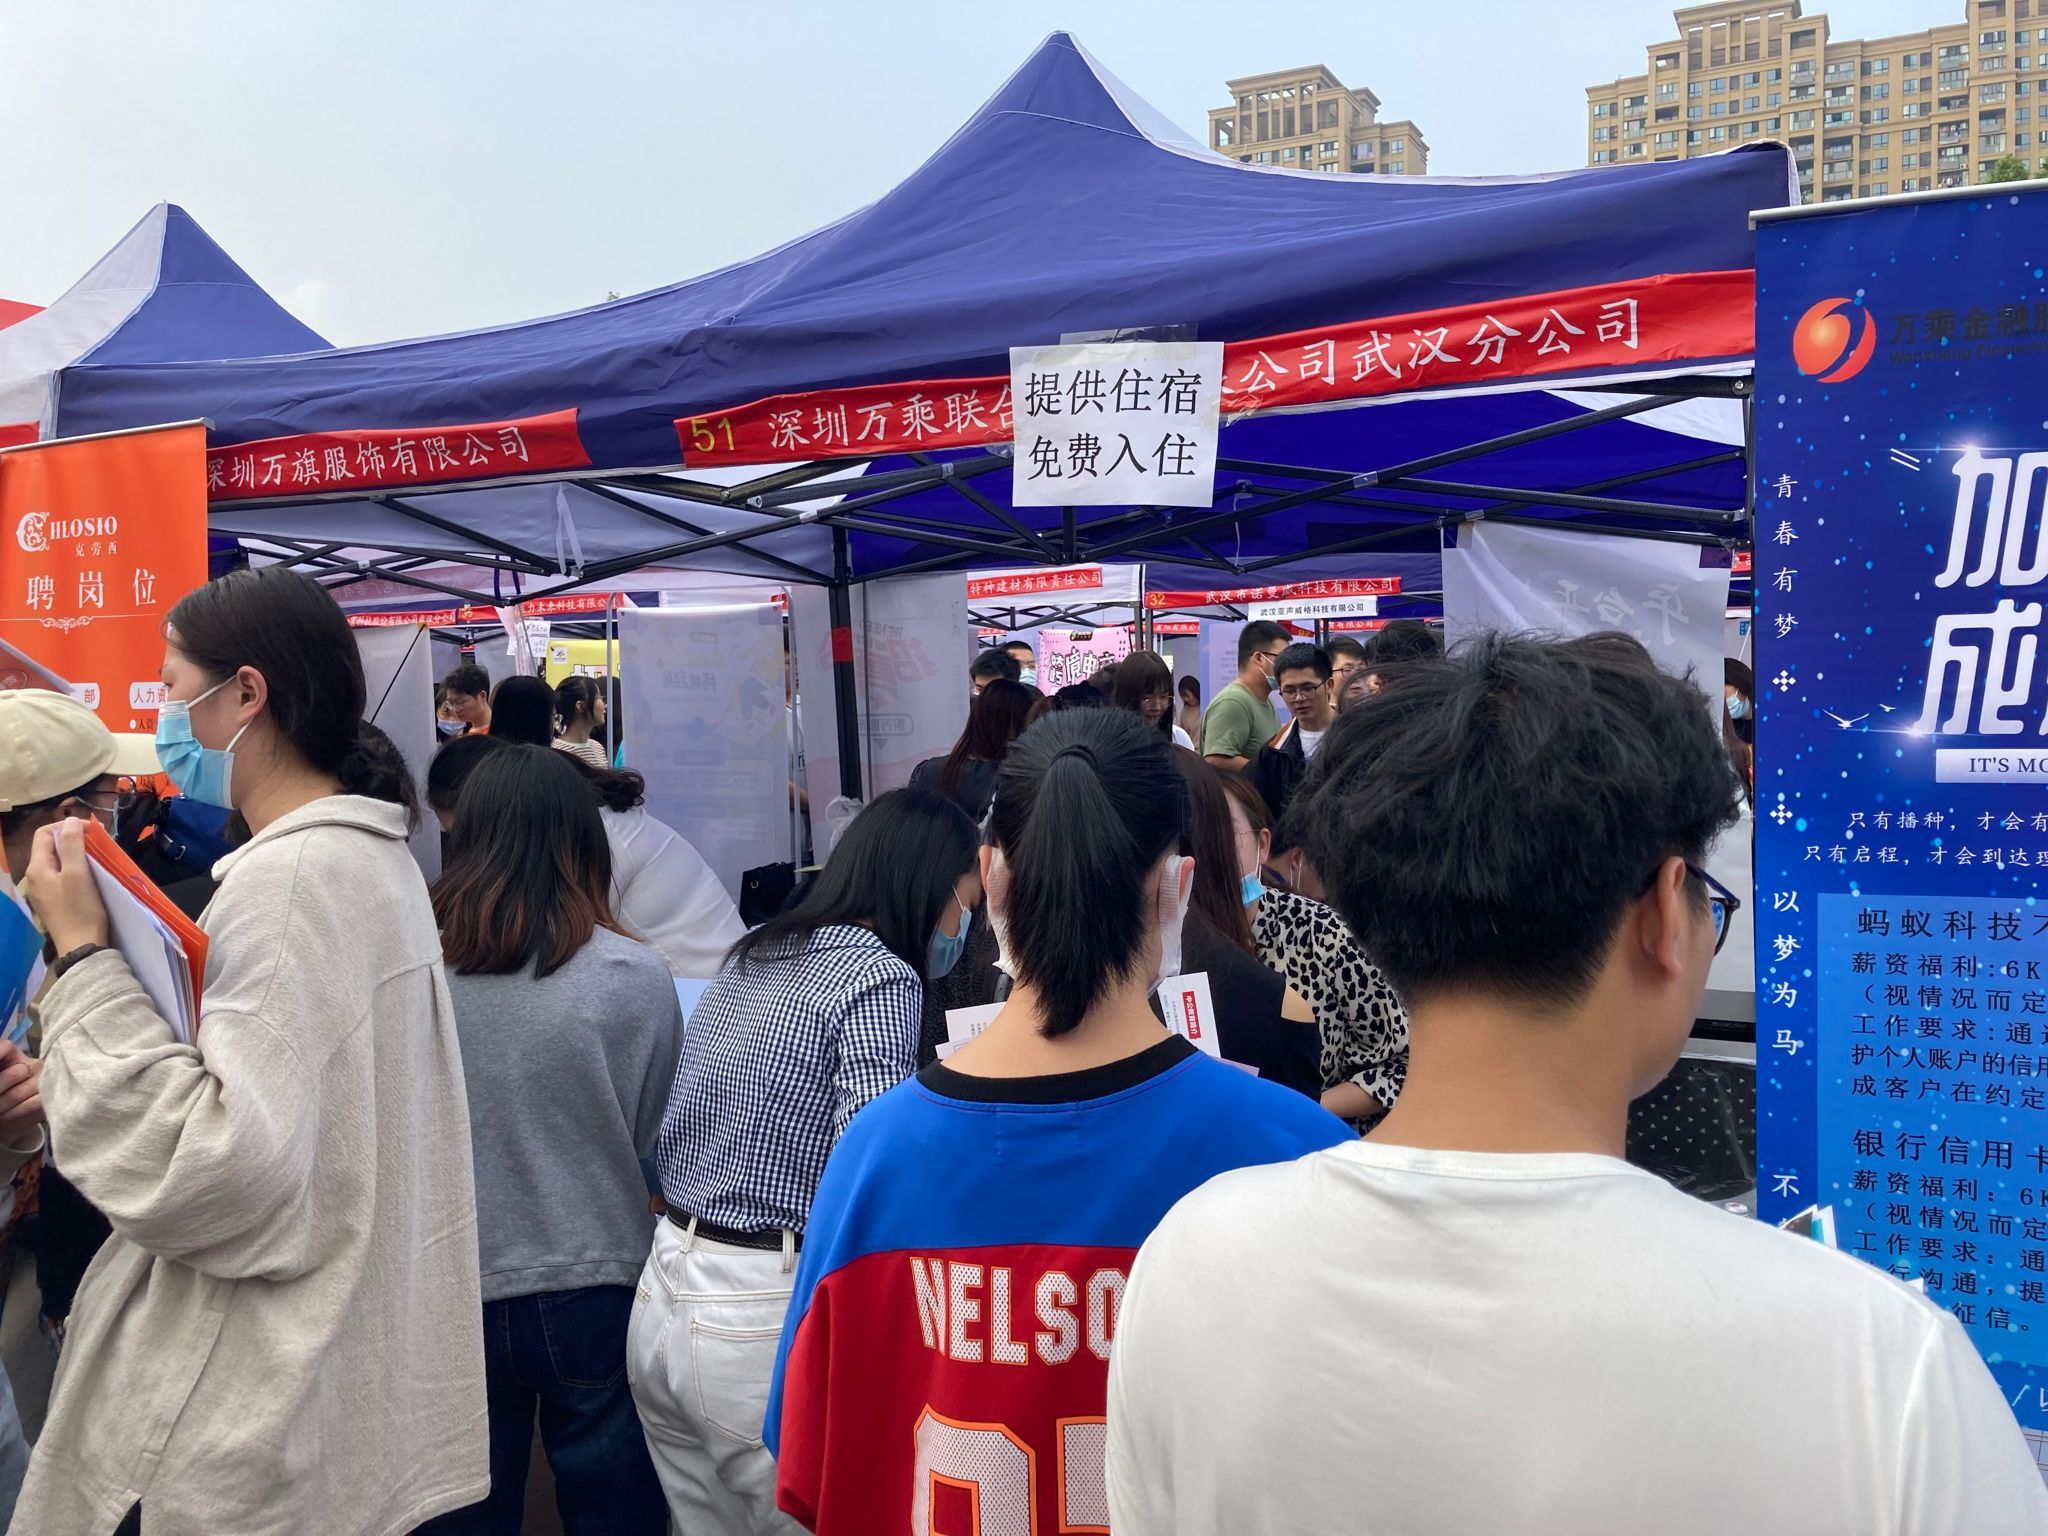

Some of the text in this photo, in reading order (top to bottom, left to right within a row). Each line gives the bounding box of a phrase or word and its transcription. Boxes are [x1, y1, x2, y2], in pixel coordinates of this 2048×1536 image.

[690, 297, 1640, 453] 51 深圳万乘联合 公司武汉分公司
[1024, 366, 1202, 417] 提供住宿
[207, 426, 529, 489] 深圳万旗服饰有限公司
[1028, 430, 1198, 480] 免费入住
[1935, 447, 2048, 588] 加
[75, 541, 117, 557] 克劳西
[1772, 473, 1799, 639] 青春有梦
[1149, 593, 1166, 607] 32
[1915, 598, 2043, 735] 成
[83, 687, 168, 703] 部 人力资
[1968, 757, 2010, 774] IT'S
[1847, 810, 2048, 832] 只有播种，才会有
[1771, 890, 1800, 1056] 以梦为马
[1851, 1074, 2047, 1111] 成客户在约定
